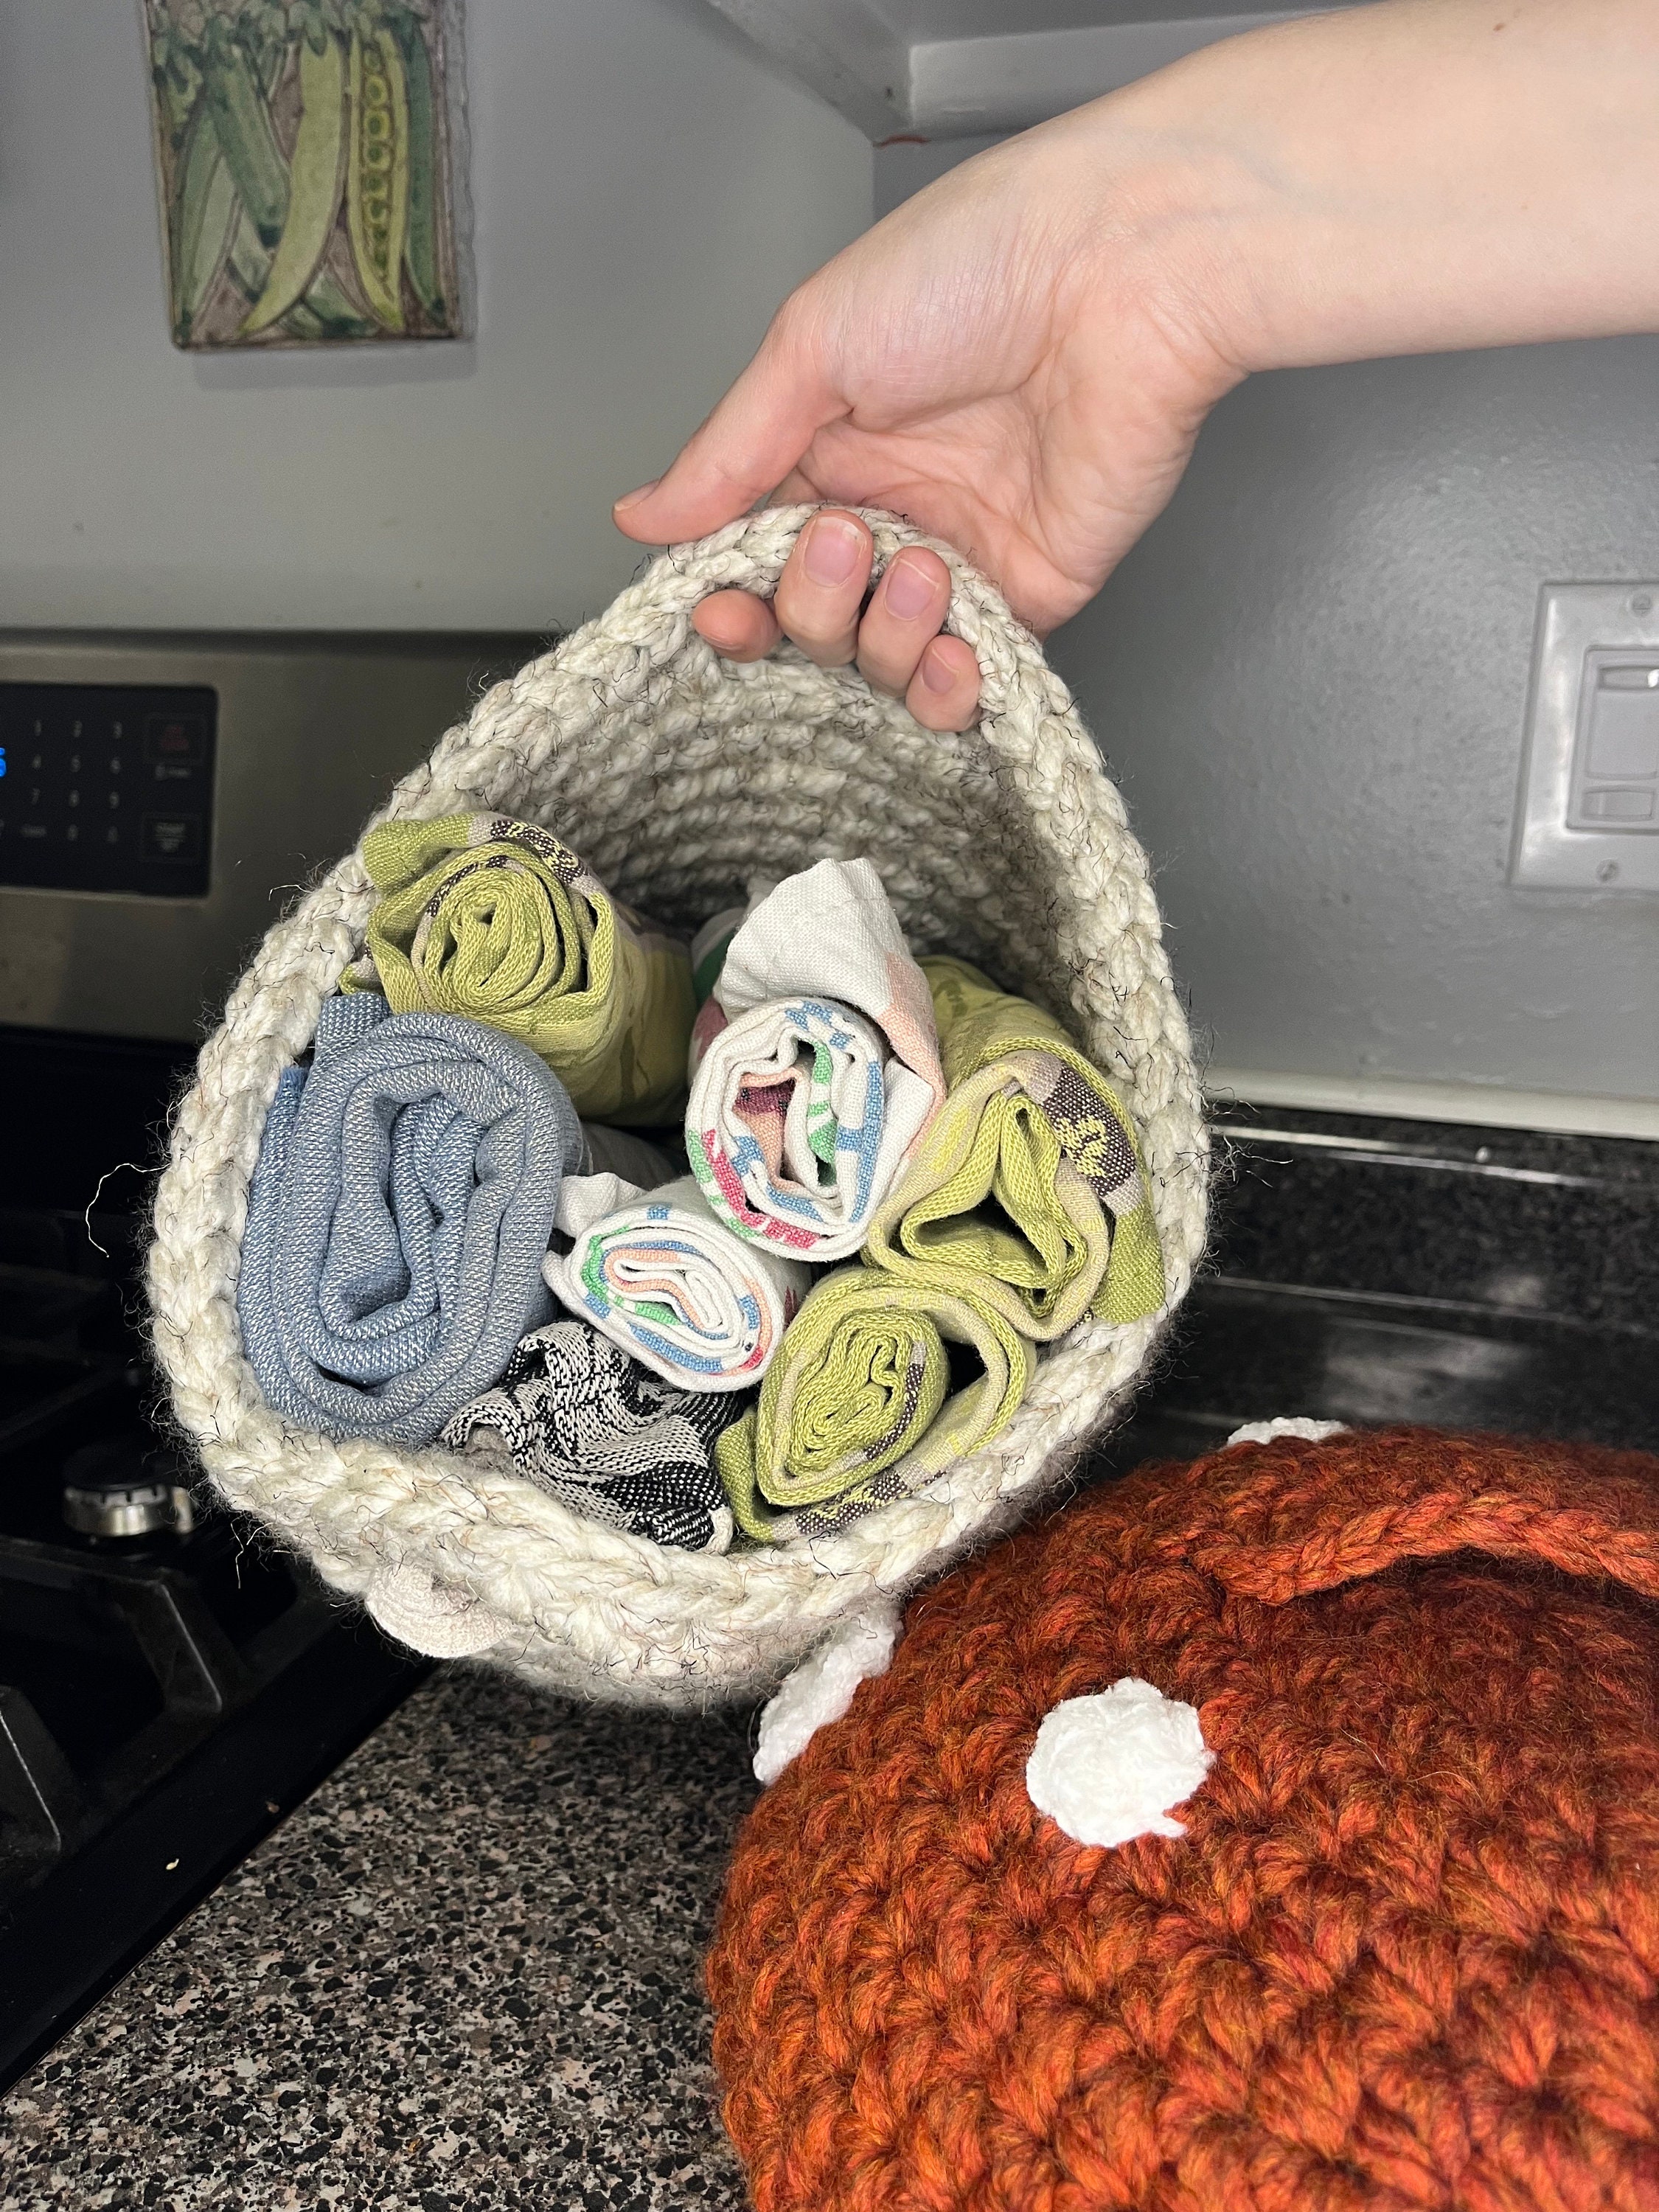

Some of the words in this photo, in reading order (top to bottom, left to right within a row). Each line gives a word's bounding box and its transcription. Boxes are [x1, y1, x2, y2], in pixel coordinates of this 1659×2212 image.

[35, 720, 42, 736] 1
[74, 720, 83, 737] 2
[114, 722, 122, 739] 3
[32, 787, 41, 804] 7
